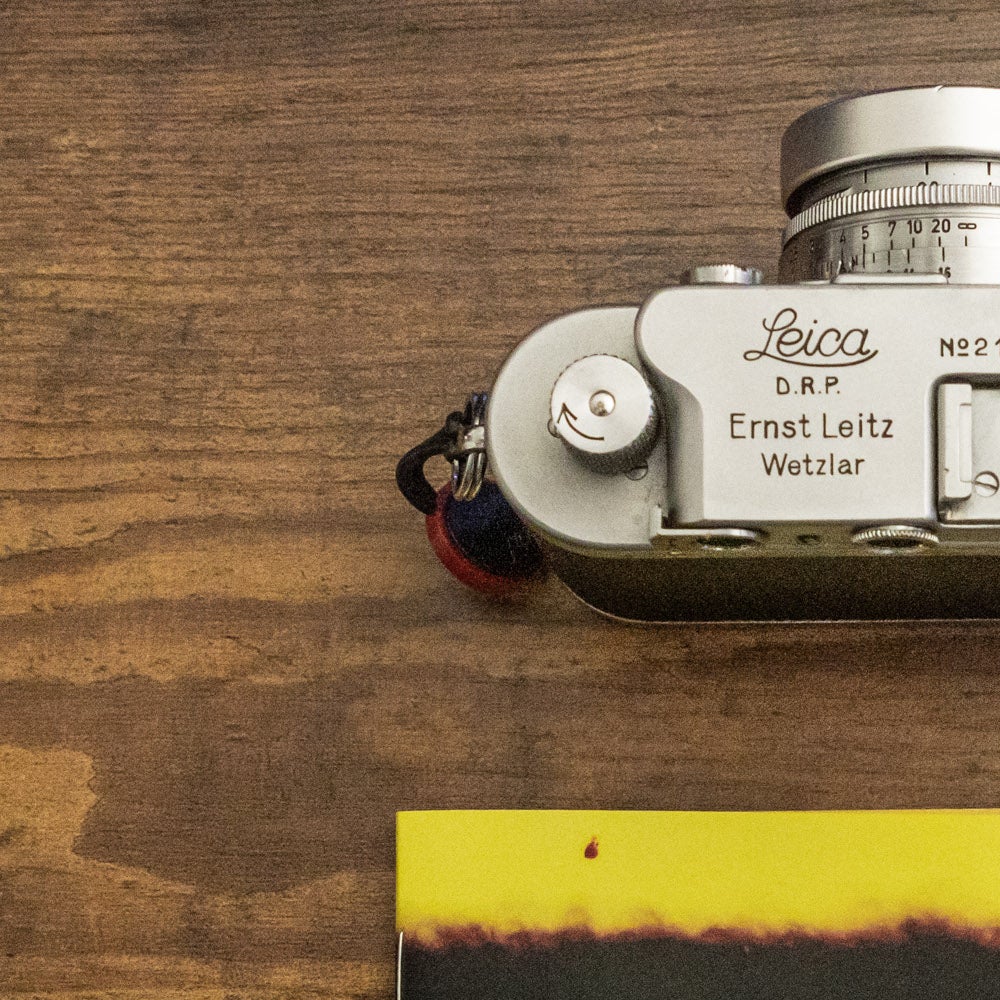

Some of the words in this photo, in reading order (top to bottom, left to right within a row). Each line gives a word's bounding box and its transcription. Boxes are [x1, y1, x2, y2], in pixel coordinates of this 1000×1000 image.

[862, 225, 869, 240] 5
[888, 220, 896, 236] 7
[907, 219, 922, 234] 10
[932, 219, 950, 233] 20
[743, 307, 878, 367] Leica
[776, 377, 841, 395] D.R.P.
[730, 413, 811, 439] Ernst
[823, 413, 894, 439] Leitz
[761, 453, 865, 477] Wetzlar
